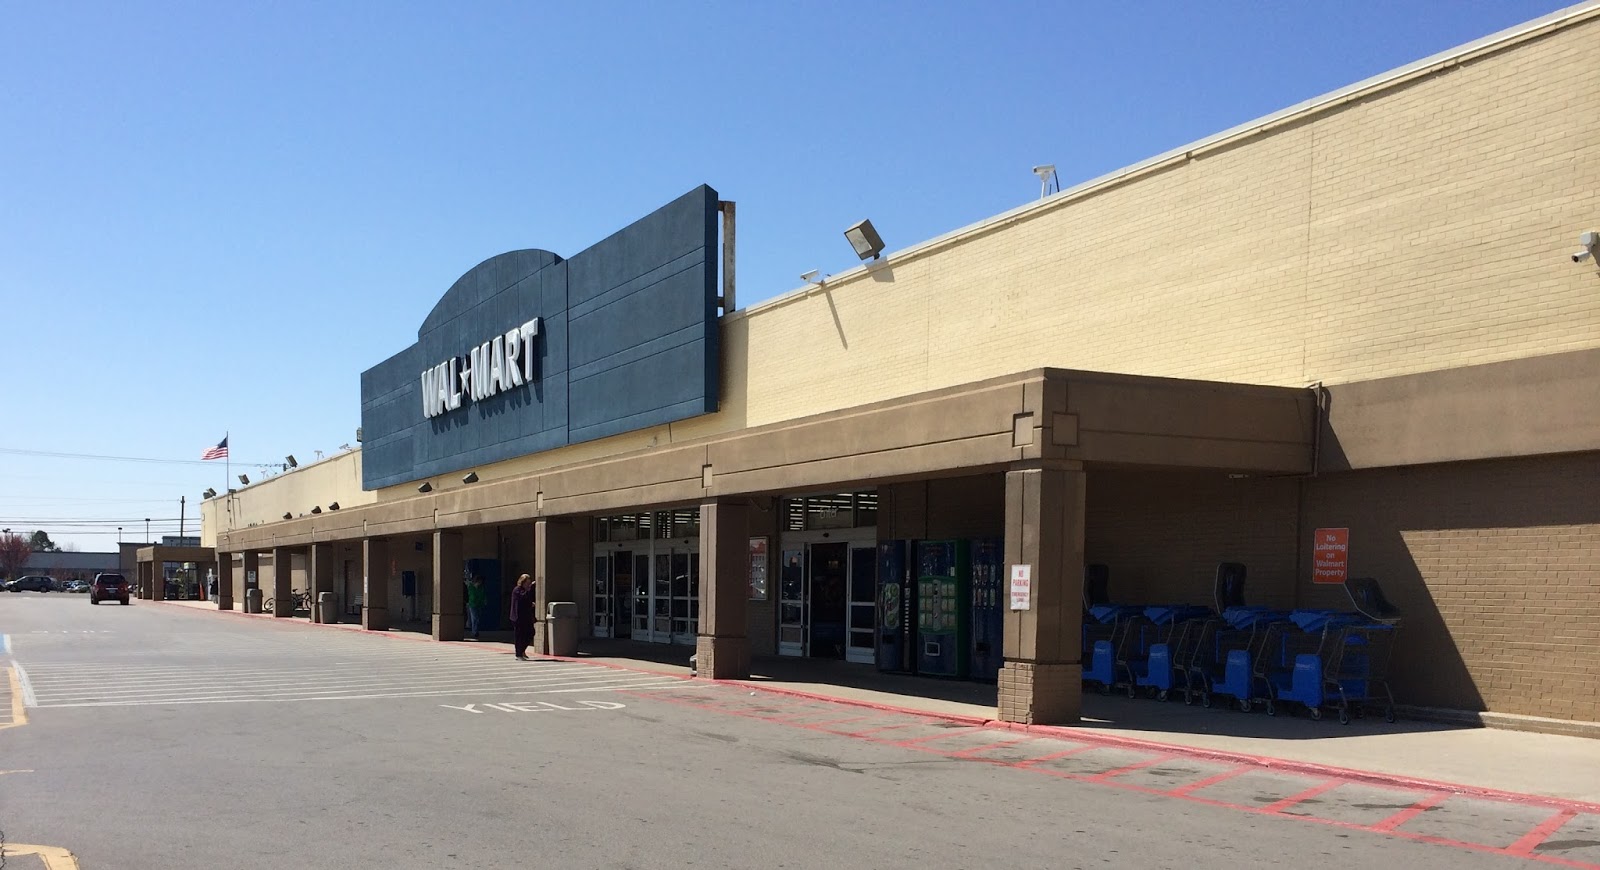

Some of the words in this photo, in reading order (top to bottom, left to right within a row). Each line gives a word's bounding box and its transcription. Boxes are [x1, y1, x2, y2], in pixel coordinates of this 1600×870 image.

[1316, 543, 1346, 552] Loitering
[1316, 559, 1345, 567] Walmart
[1315, 568, 1344, 577] Property
[439, 700, 626, 714] YIELD
